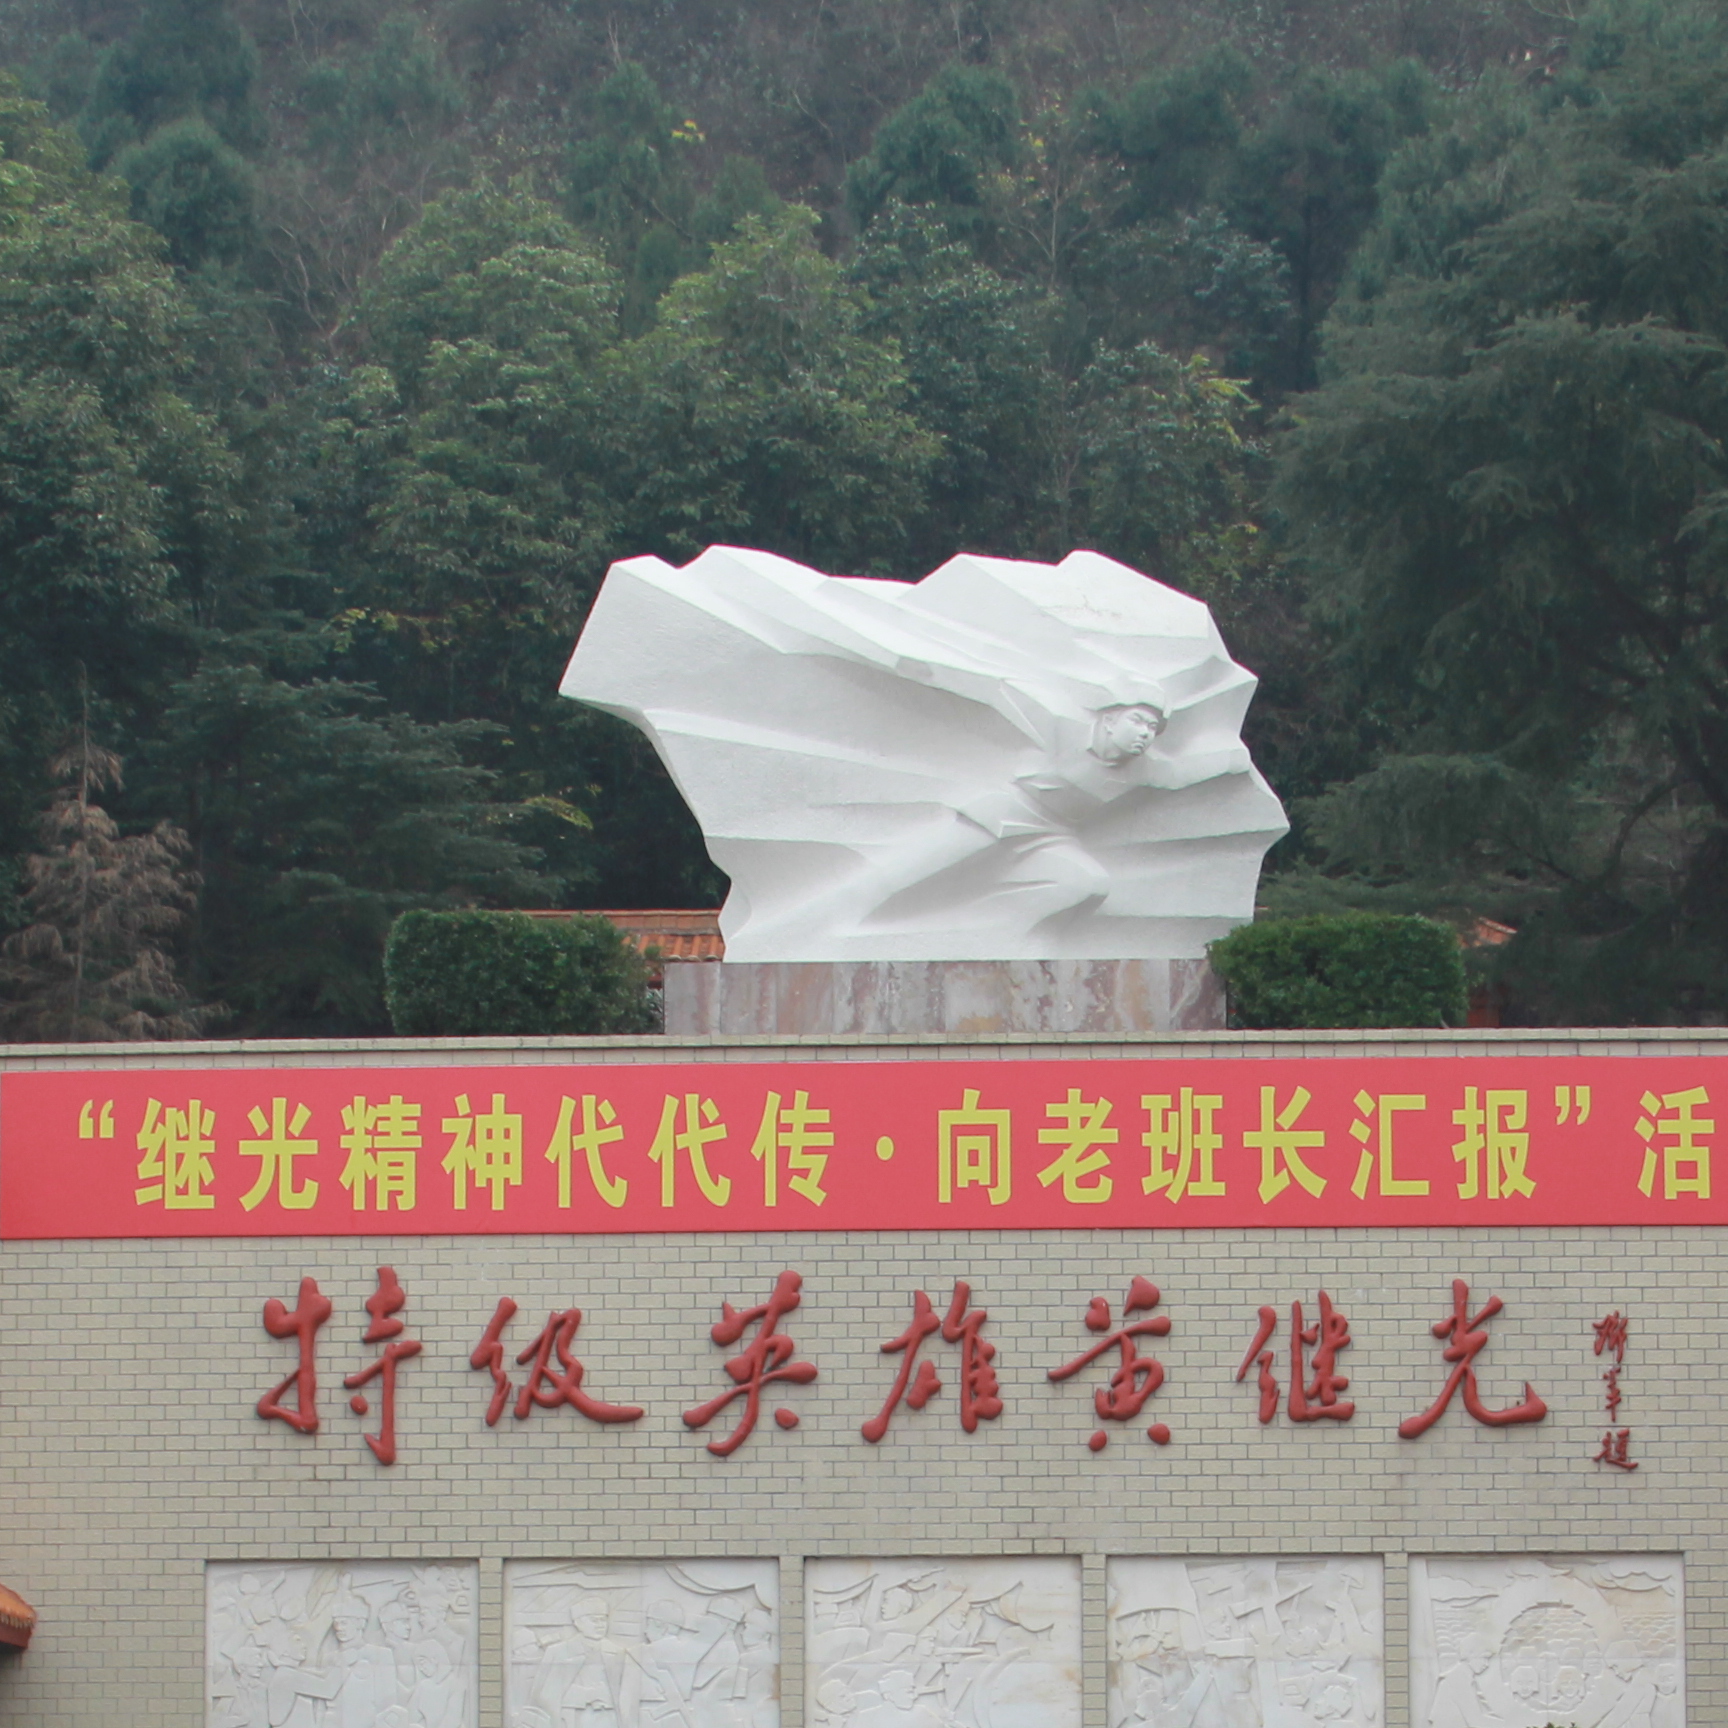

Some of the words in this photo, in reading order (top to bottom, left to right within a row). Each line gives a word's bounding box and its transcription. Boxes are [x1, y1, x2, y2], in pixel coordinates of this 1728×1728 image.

[256, 1266, 1546, 1465] 特级英雄黄继光
